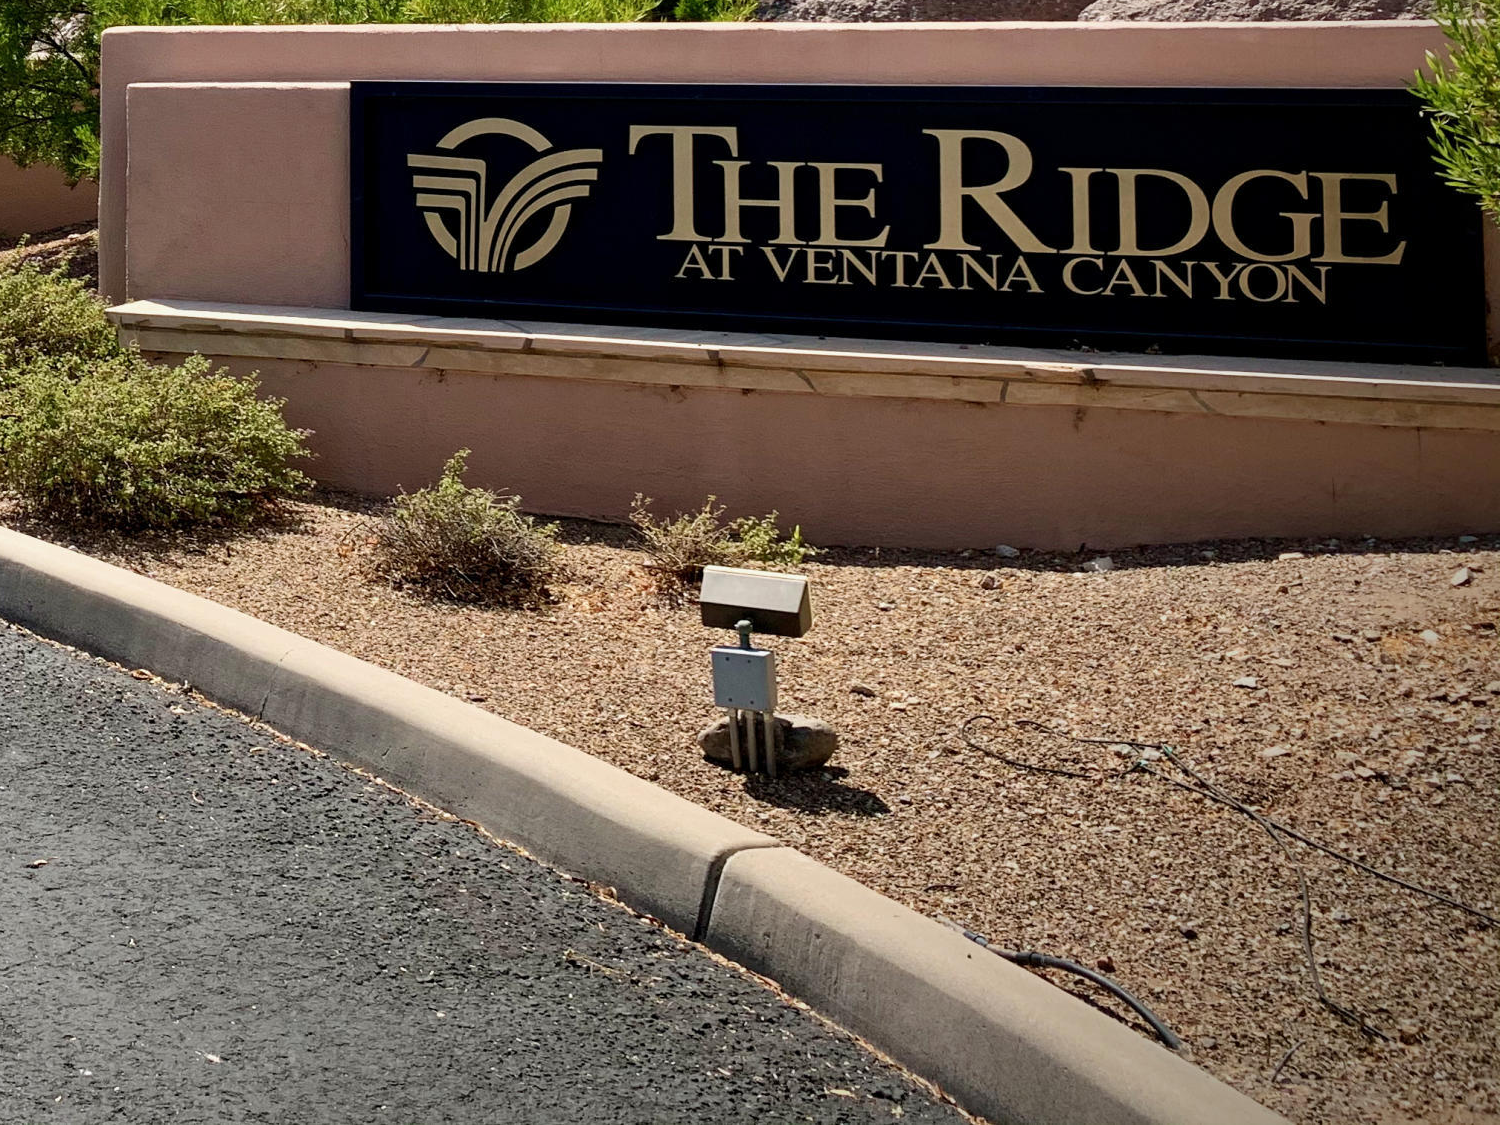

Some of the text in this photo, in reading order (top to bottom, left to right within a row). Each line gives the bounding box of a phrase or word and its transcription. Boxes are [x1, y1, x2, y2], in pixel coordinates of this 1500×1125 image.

[628, 124, 1406, 265] THE RIDGE
[675, 243, 1332, 304] AT VENTANA CANYON
